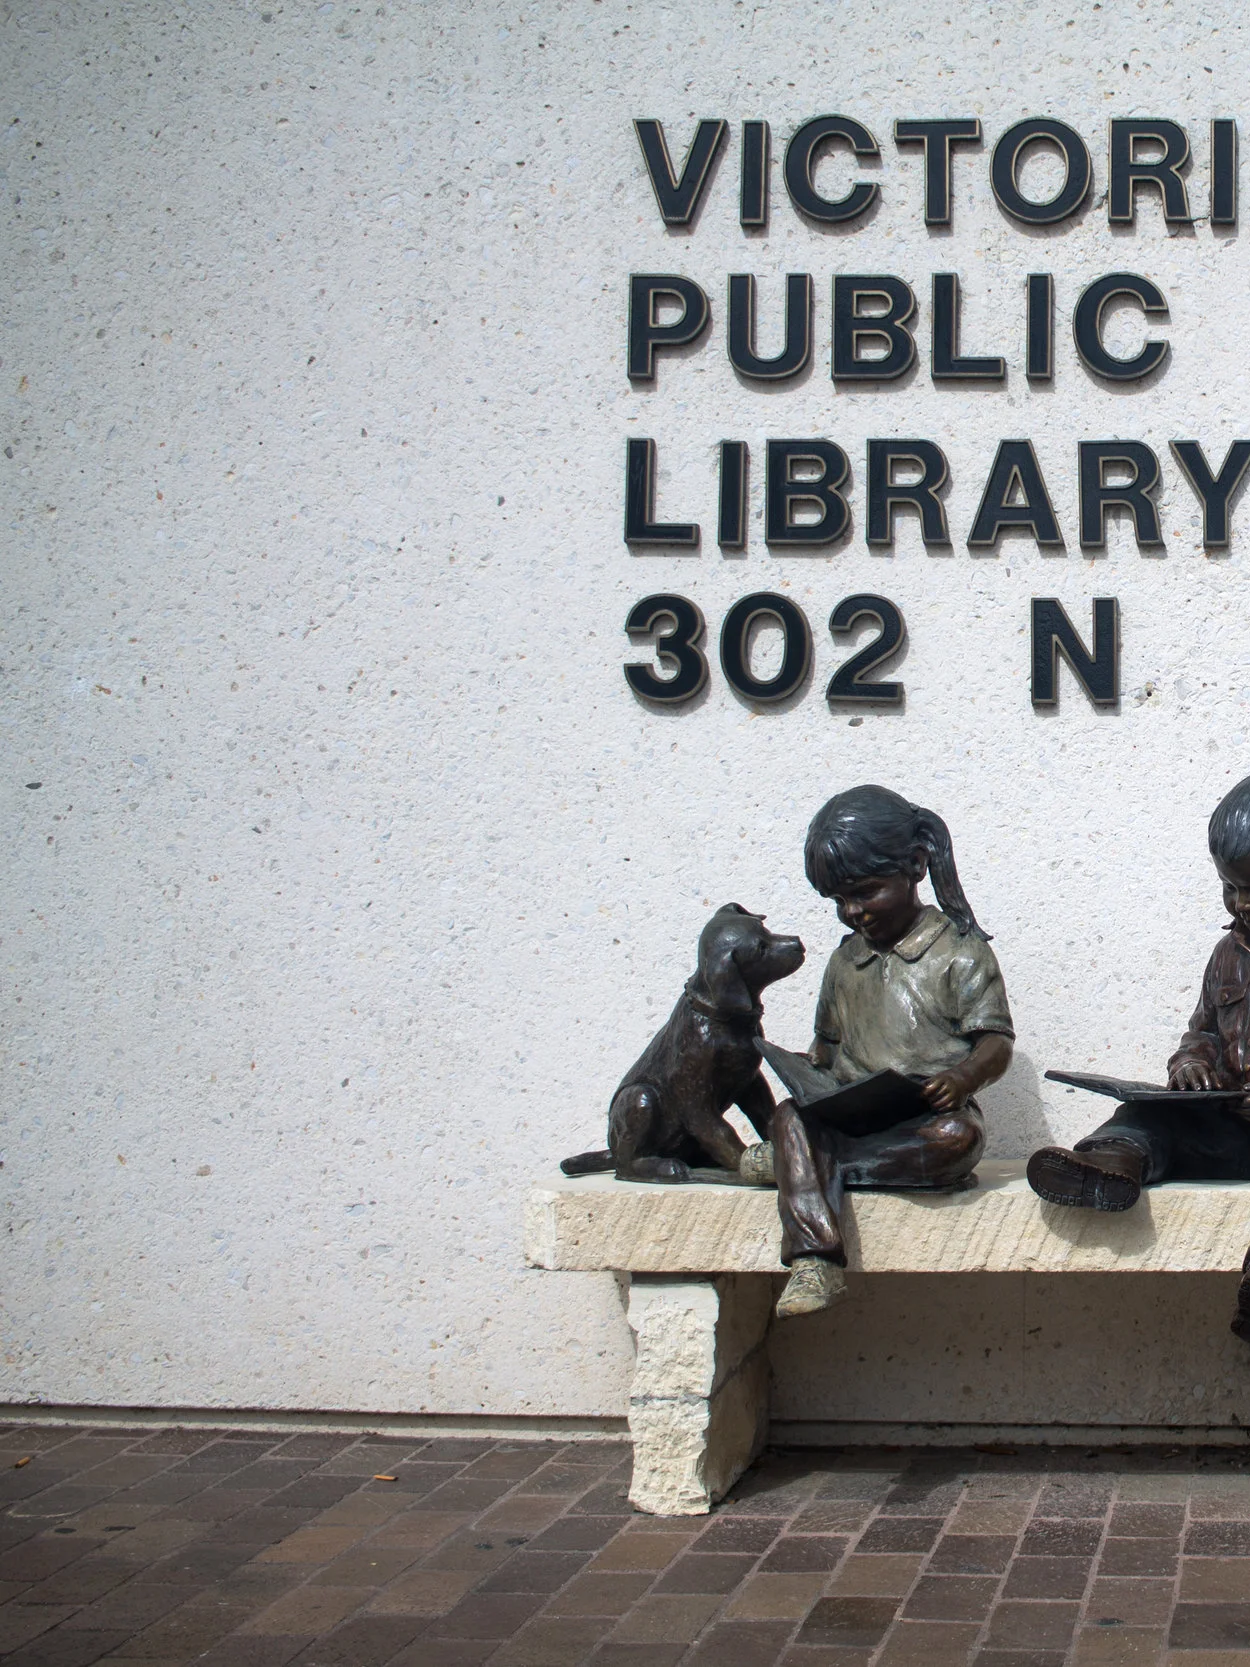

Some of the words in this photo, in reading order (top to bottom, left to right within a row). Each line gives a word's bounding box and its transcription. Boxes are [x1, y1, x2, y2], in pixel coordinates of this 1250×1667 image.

[627, 271, 1170, 381] PUBLIC
[623, 592, 907, 706] 302
[1030, 597, 1118, 707] N
